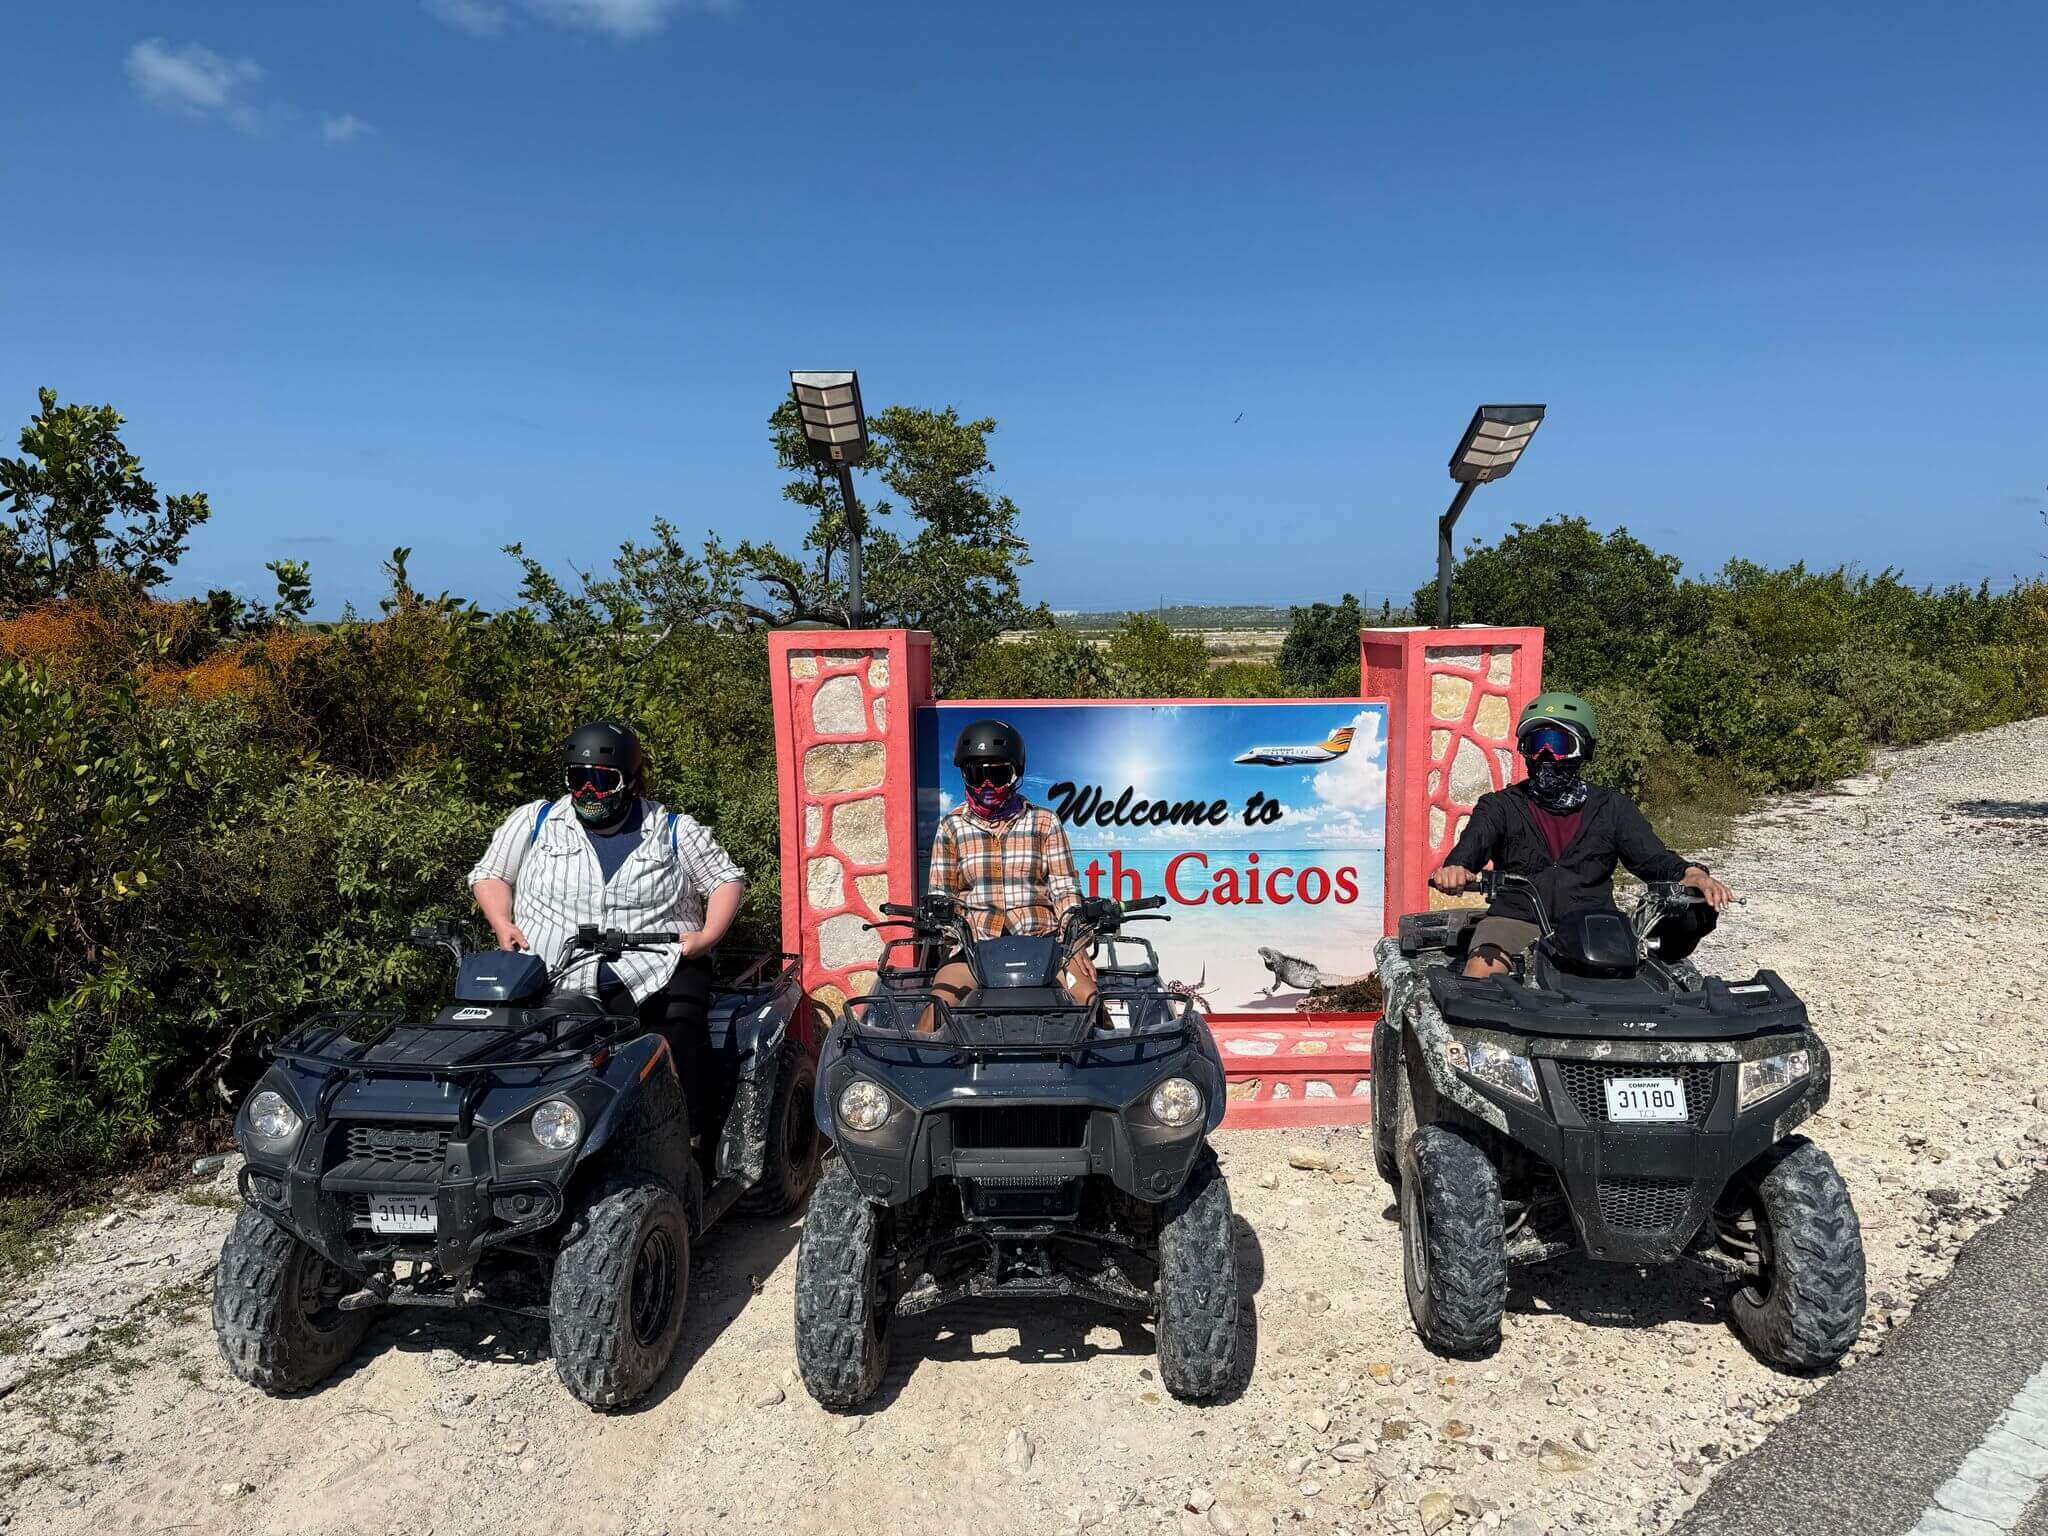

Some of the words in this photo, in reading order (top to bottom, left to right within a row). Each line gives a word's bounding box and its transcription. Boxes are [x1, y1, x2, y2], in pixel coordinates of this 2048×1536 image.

[1047, 782, 1229, 828] Welcome
[1243, 791, 1283, 827] to
[1074, 849, 1143, 902] th
[1164, 851, 1360, 906] Caicos
[1618, 1091, 1675, 1109] 31180
[379, 1205, 429, 1222] 31174
